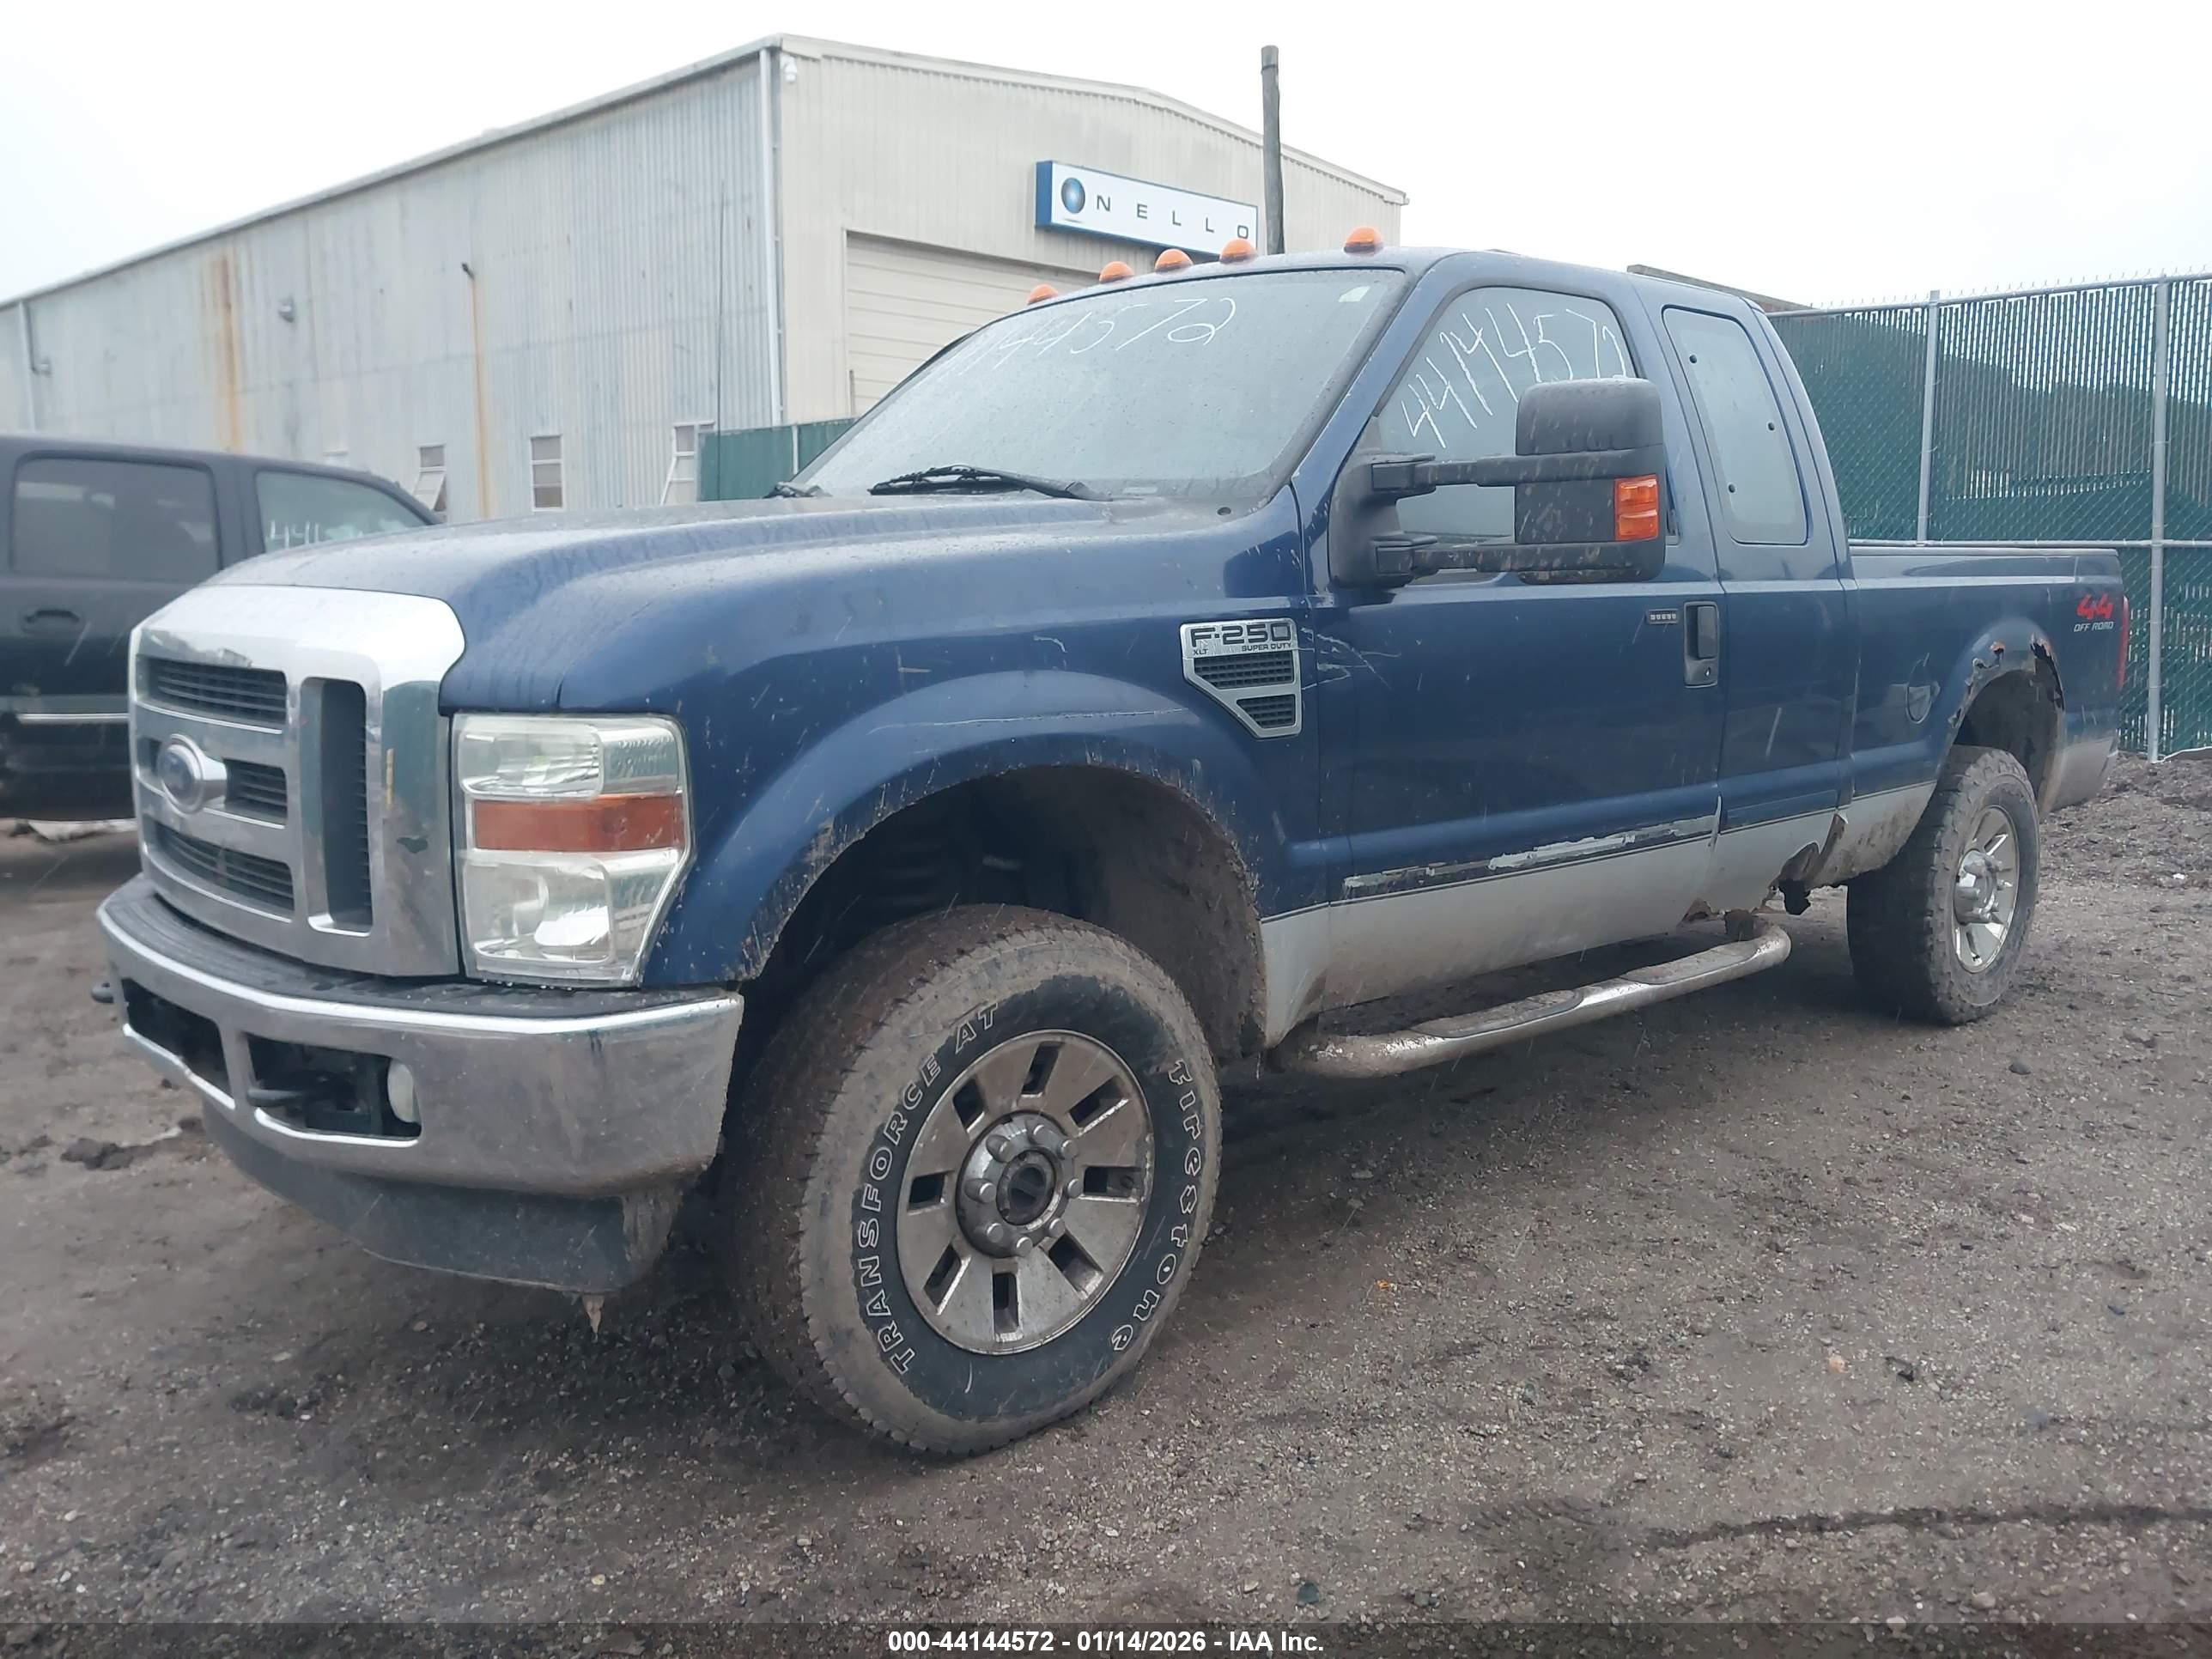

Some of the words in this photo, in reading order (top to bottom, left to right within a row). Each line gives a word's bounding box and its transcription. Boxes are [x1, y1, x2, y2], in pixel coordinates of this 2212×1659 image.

[1190, 623, 1291, 647] F-250
[2074, 623, 2091, 632] OFF
[1242, 644, 1269, 653] SUPER
[858, 1054, 942, 1375] TRANSFORCE
[954, 1002, 998, 1054] AT
